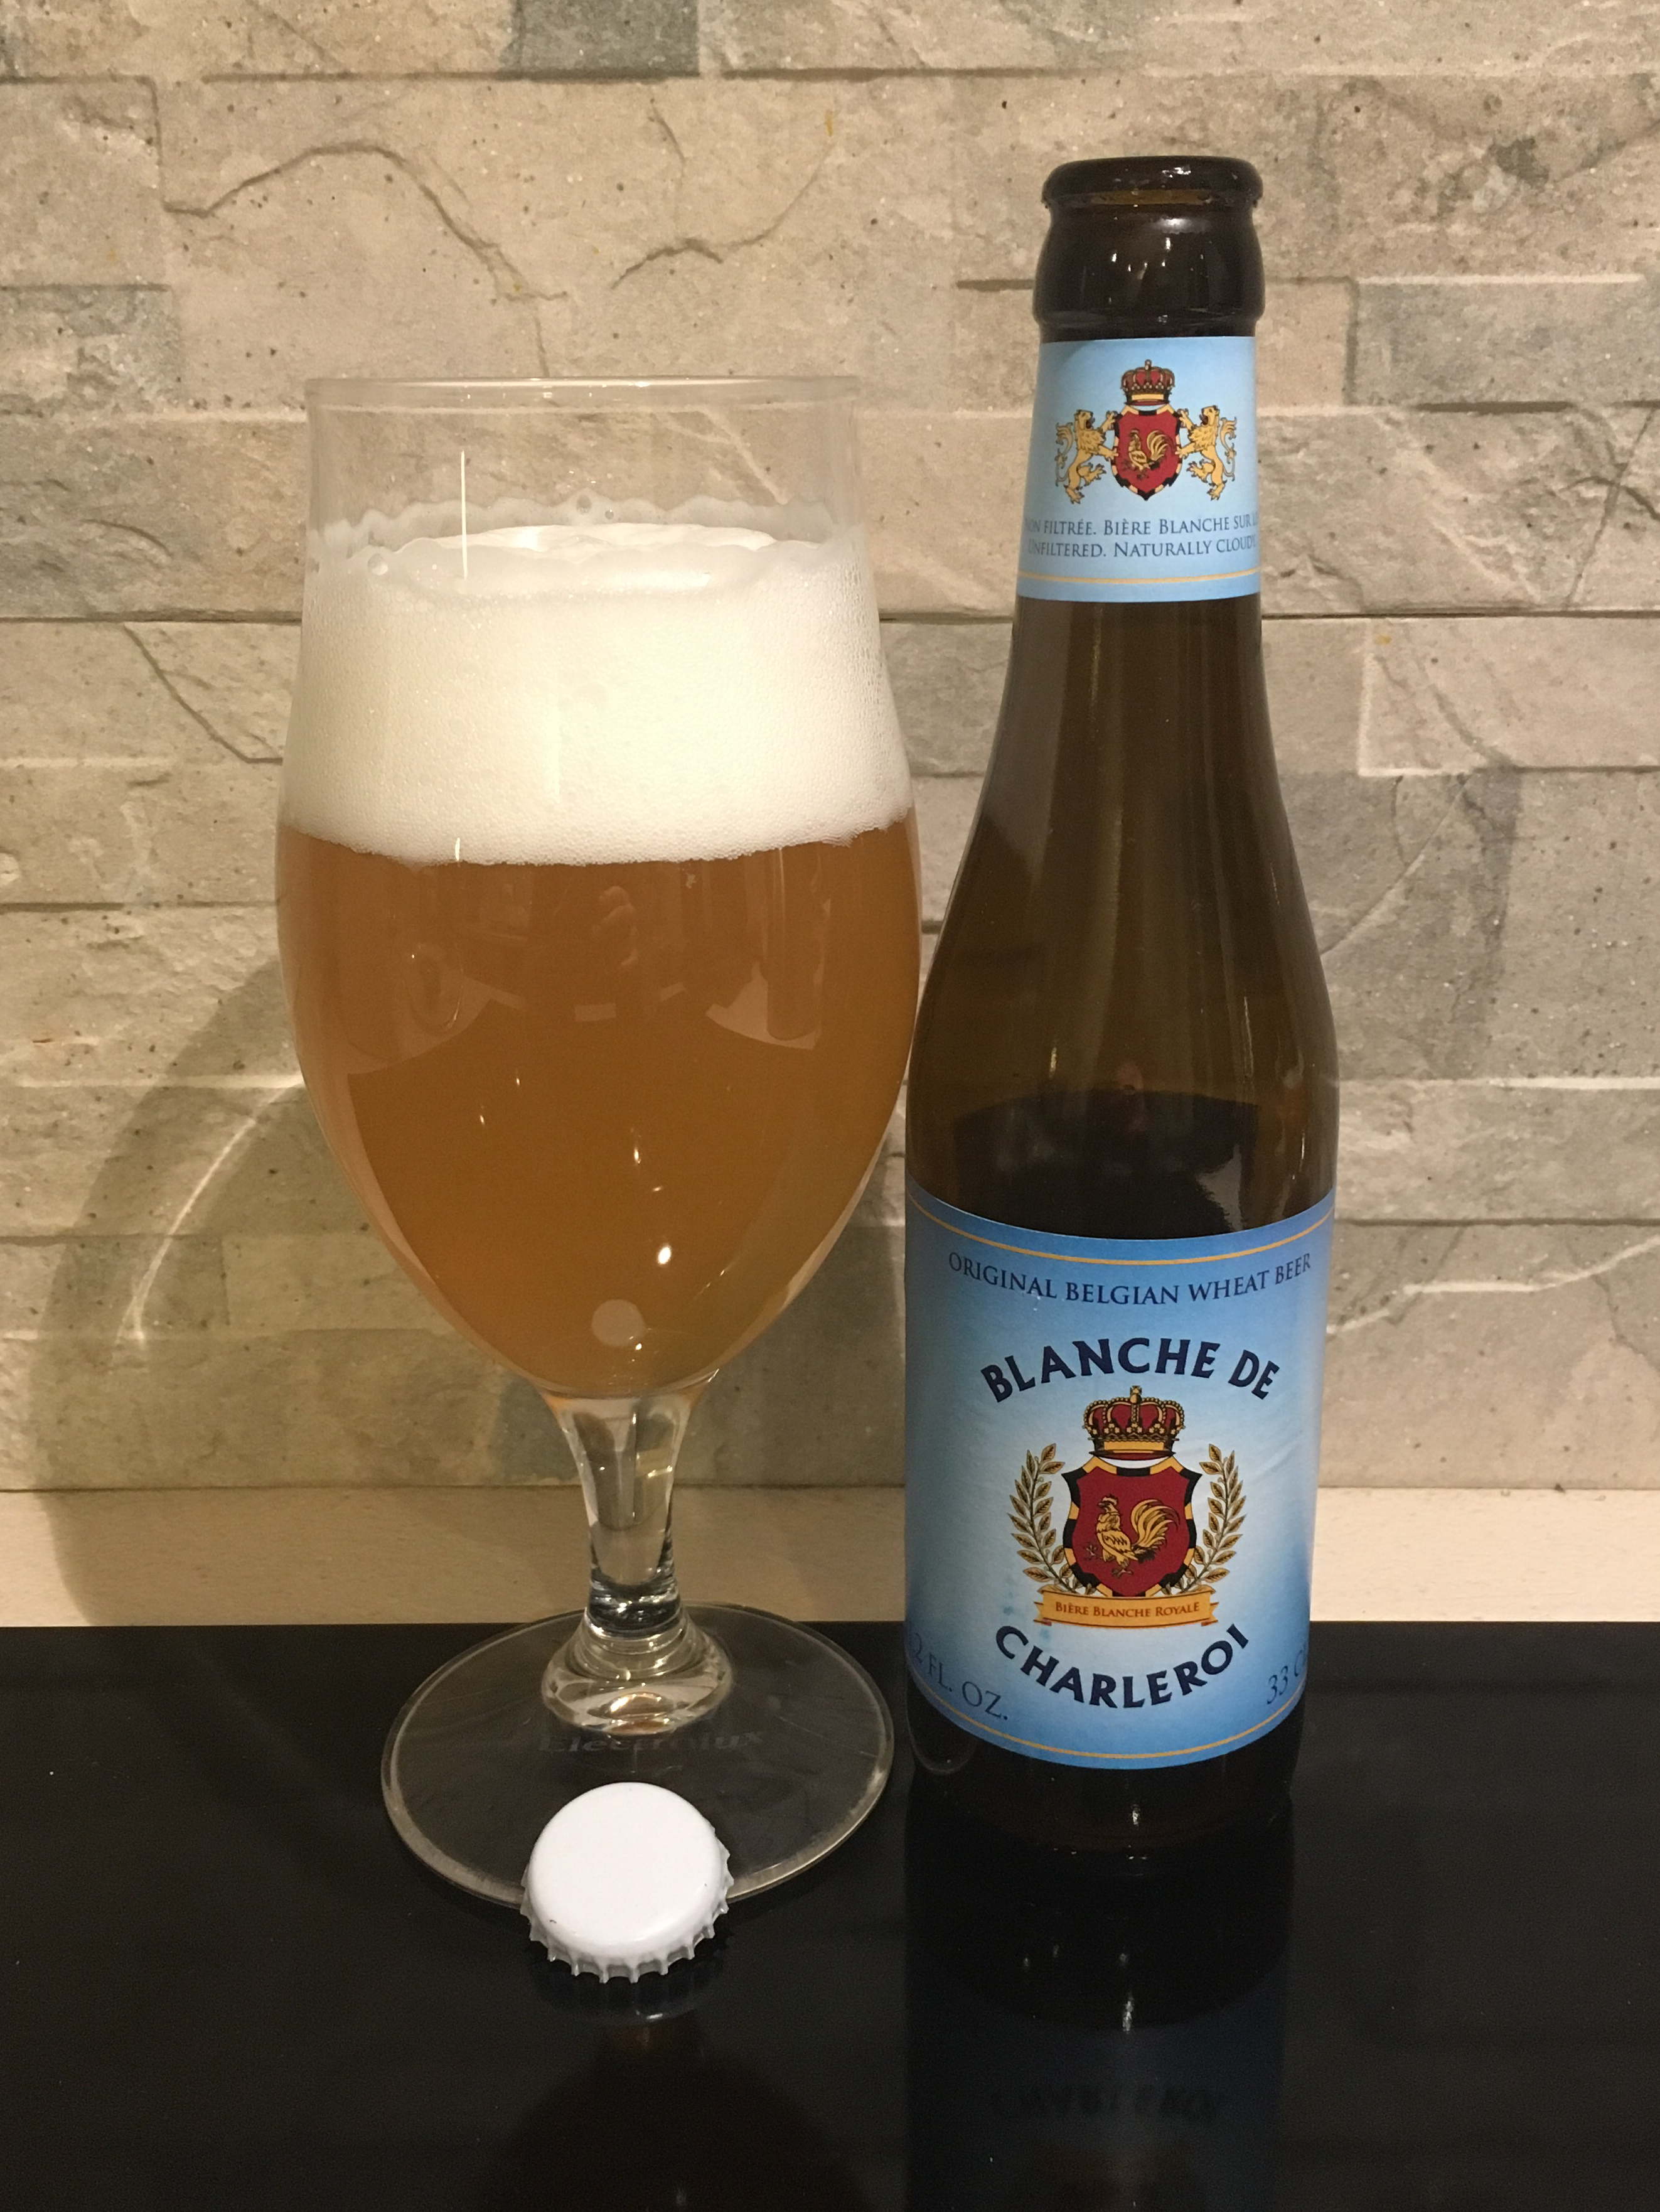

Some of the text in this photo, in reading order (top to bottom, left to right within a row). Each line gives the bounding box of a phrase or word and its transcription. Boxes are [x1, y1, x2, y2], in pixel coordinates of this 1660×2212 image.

[1044, 518, 1096, 535] FILTRÉE.
[1103, 518, 1151, 535] BIÈRE
[1159, 517, 1229, 534] BLANCHE
[1233, 513, 1251, 530] SUR
[1028, 539, 1106, 557] UNFILTERED.
[1113, 540, 1213, 557] NATURALLY
[948, 1252, 1311, 1305] ORIGINAL BELGIAN WHEAT BEER
[980, 1337, 1280, 1404] BLANCHE DE
[1055, 1601, 1200, 1618] BIÈRE BLANCHE ROYALE
[927, 1652, 953, 1692] FL.
[961, 1680, 1008, 1721] OZ.
[995, 1623, 1250, 1709] CHARLEROI
[1266, 1665, 1288, 1705] 33
